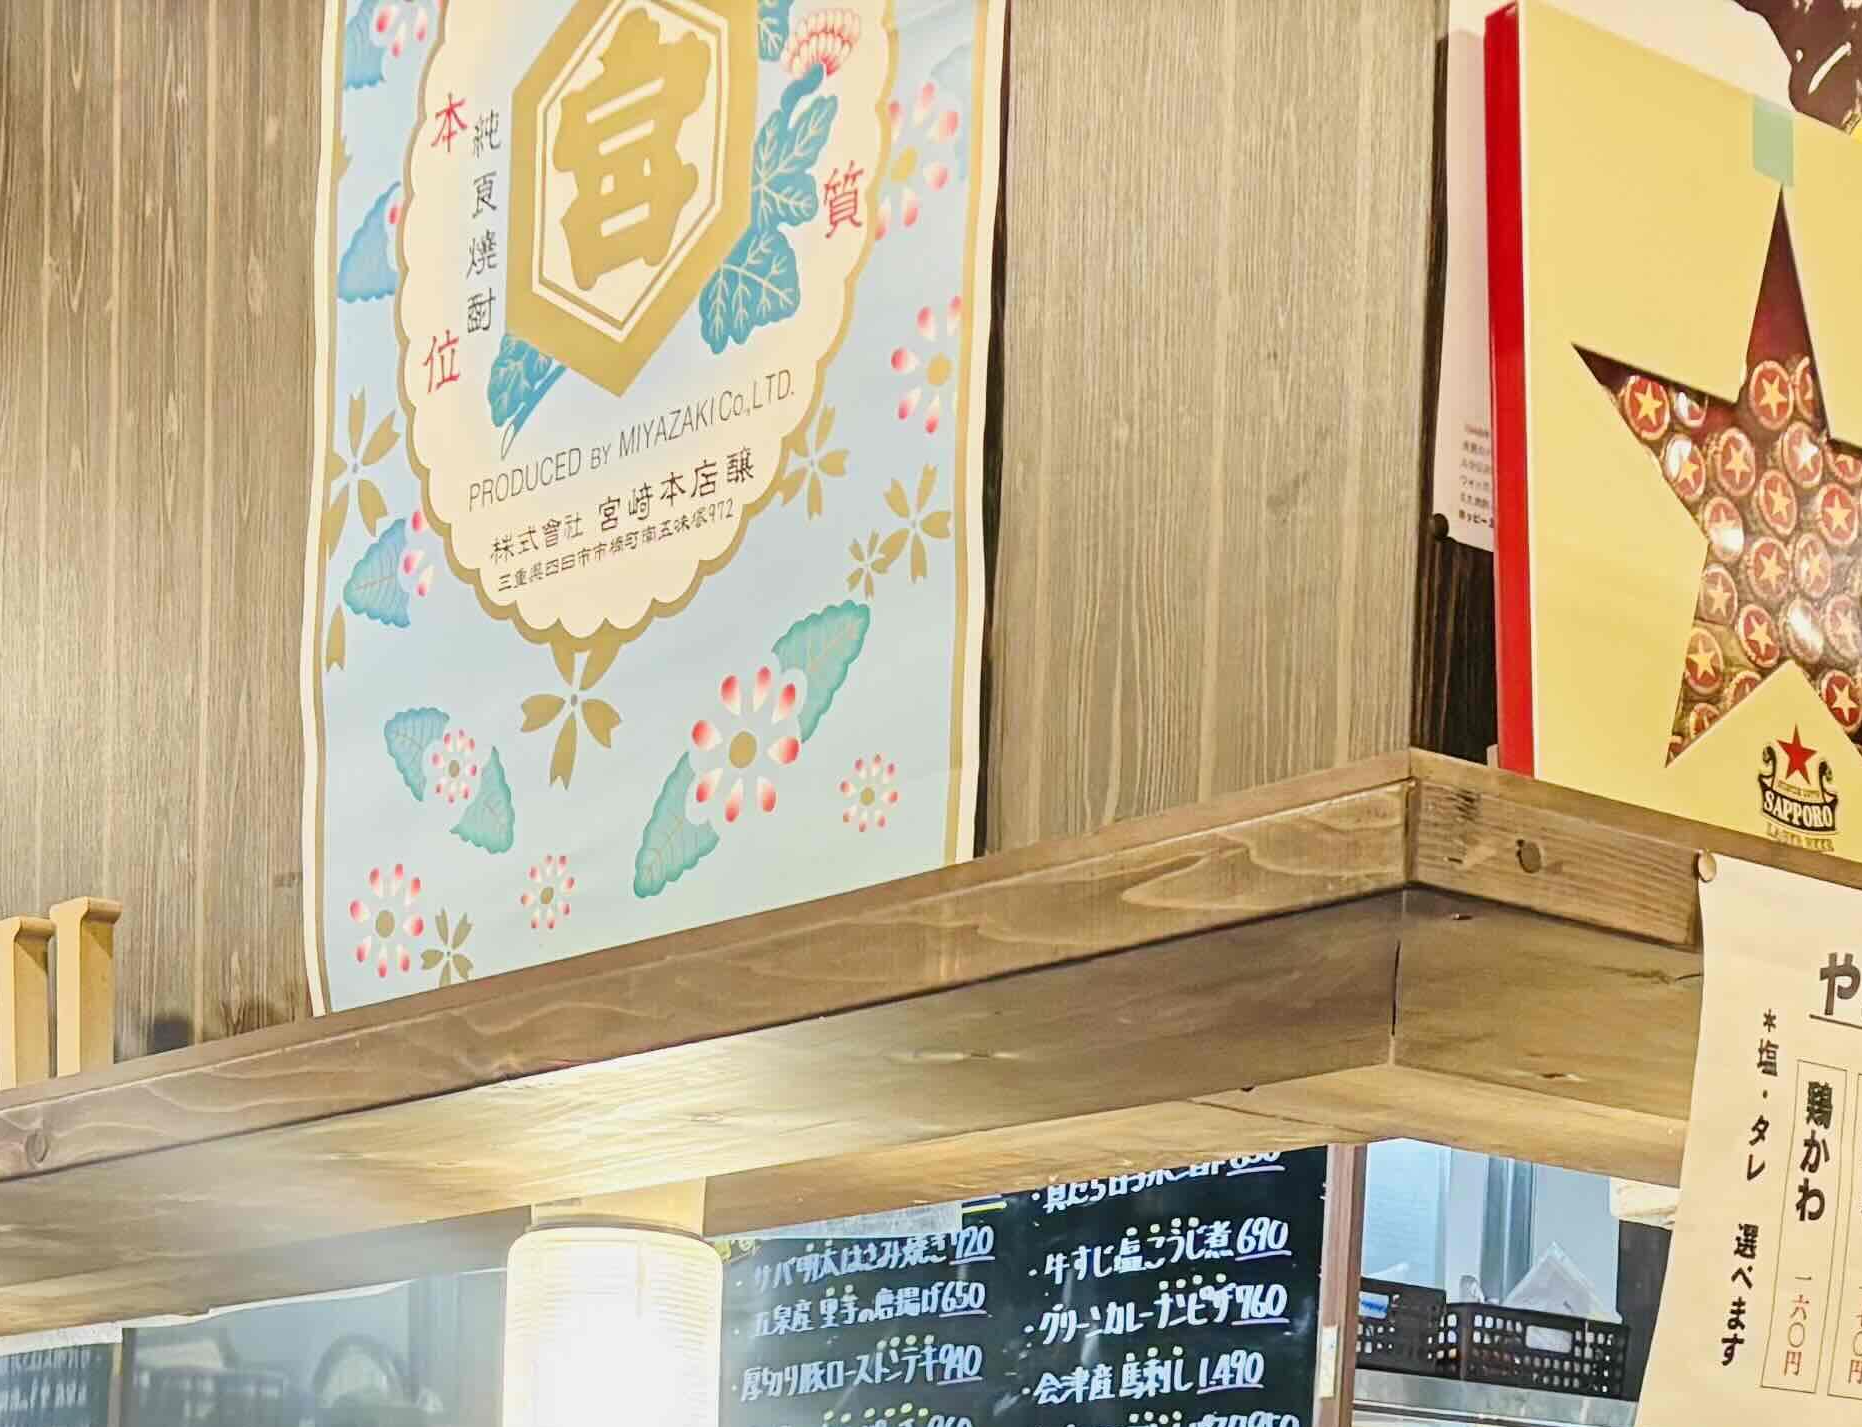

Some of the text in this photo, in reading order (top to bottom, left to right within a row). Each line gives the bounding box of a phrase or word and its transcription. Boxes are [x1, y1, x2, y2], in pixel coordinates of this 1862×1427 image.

[469, 404, 717, 512] PRODUCED BY MIYAZAKI
[1763, 789, 1833, 828] SAPPORO
[1794, 1080, 1833, 1222] 鶏かわ
[1236, 1216, 1289, 1254] 690
[941, 1280, 987, 1314] 650
[1235, 1283, 1288, 1320] 760
[1721, 1222, 1760, 1367] 選べます
